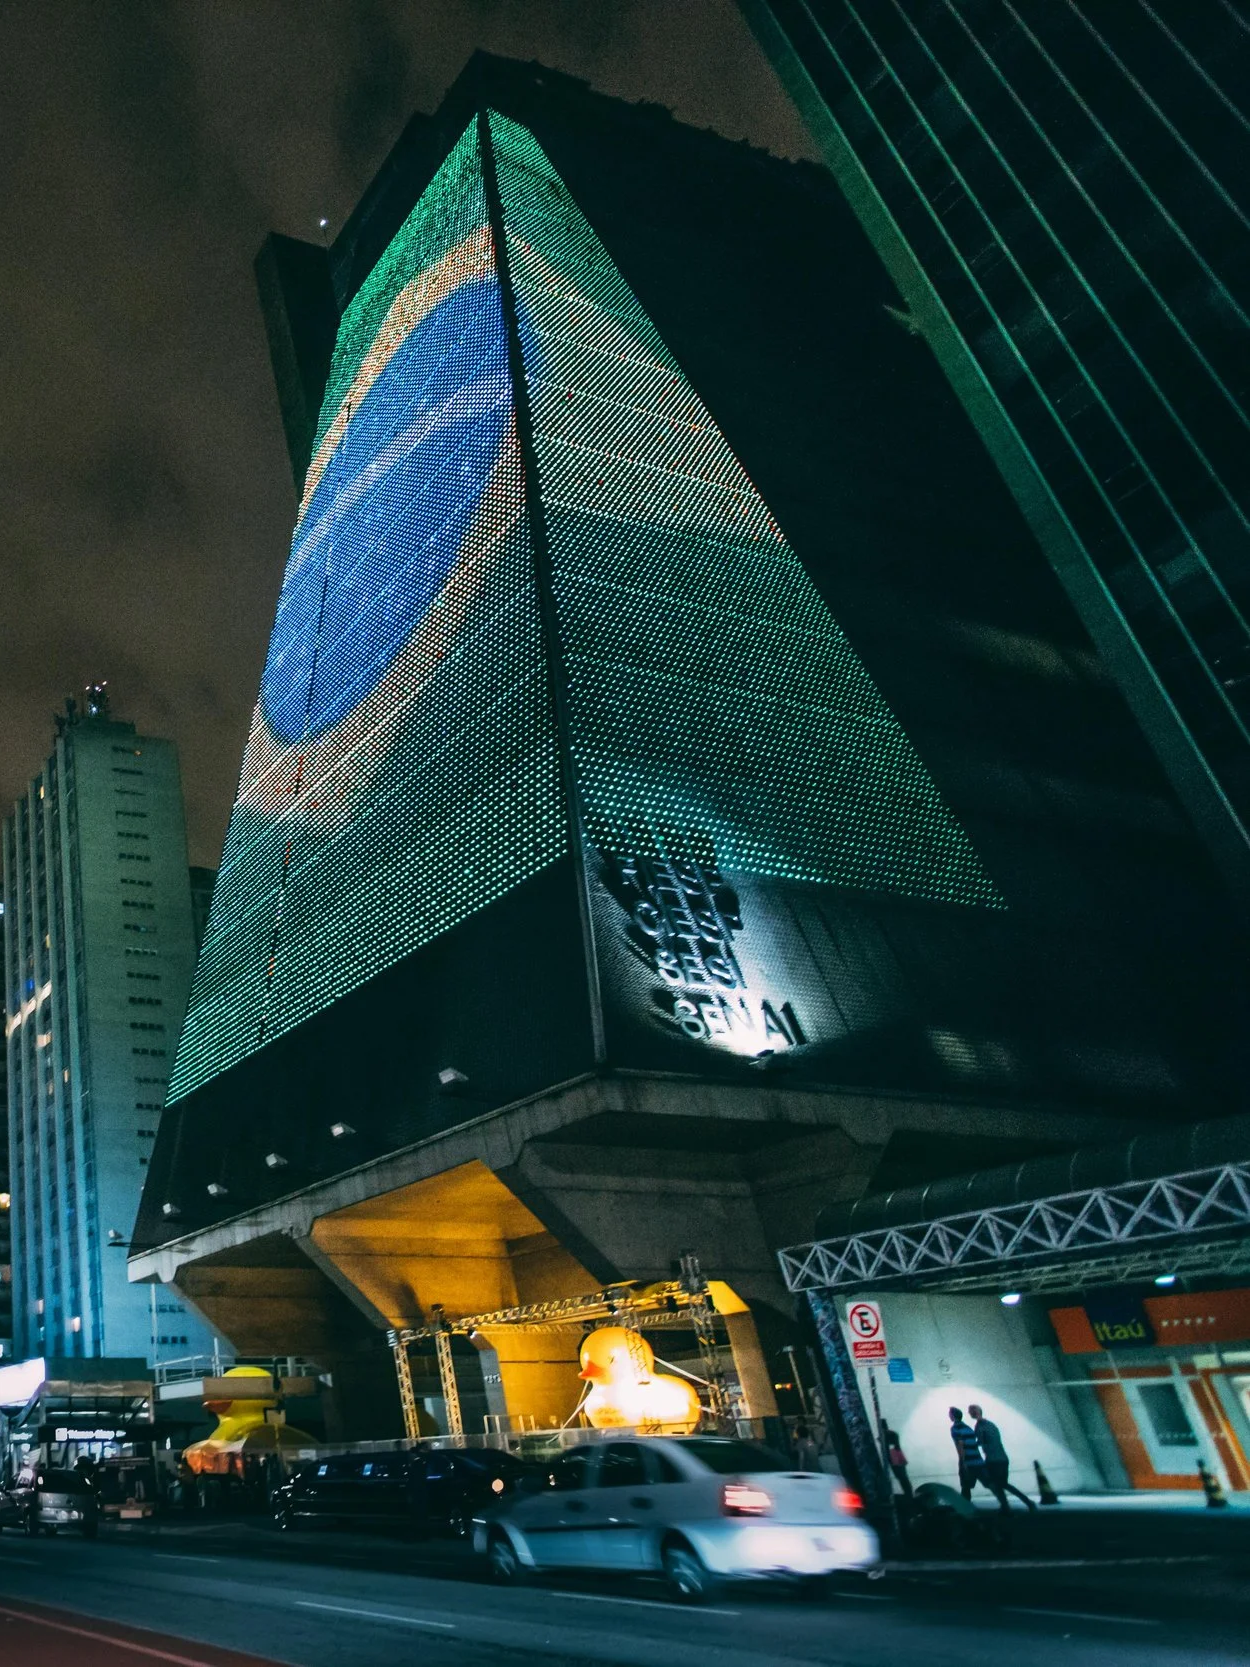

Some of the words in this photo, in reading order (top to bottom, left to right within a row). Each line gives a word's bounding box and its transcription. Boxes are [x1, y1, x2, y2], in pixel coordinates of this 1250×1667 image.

[655, 946, 747, 990] SESI
[673, 994, 808, 1046] SENAI
[1093, 1317, 1146, 1341] Itaú
